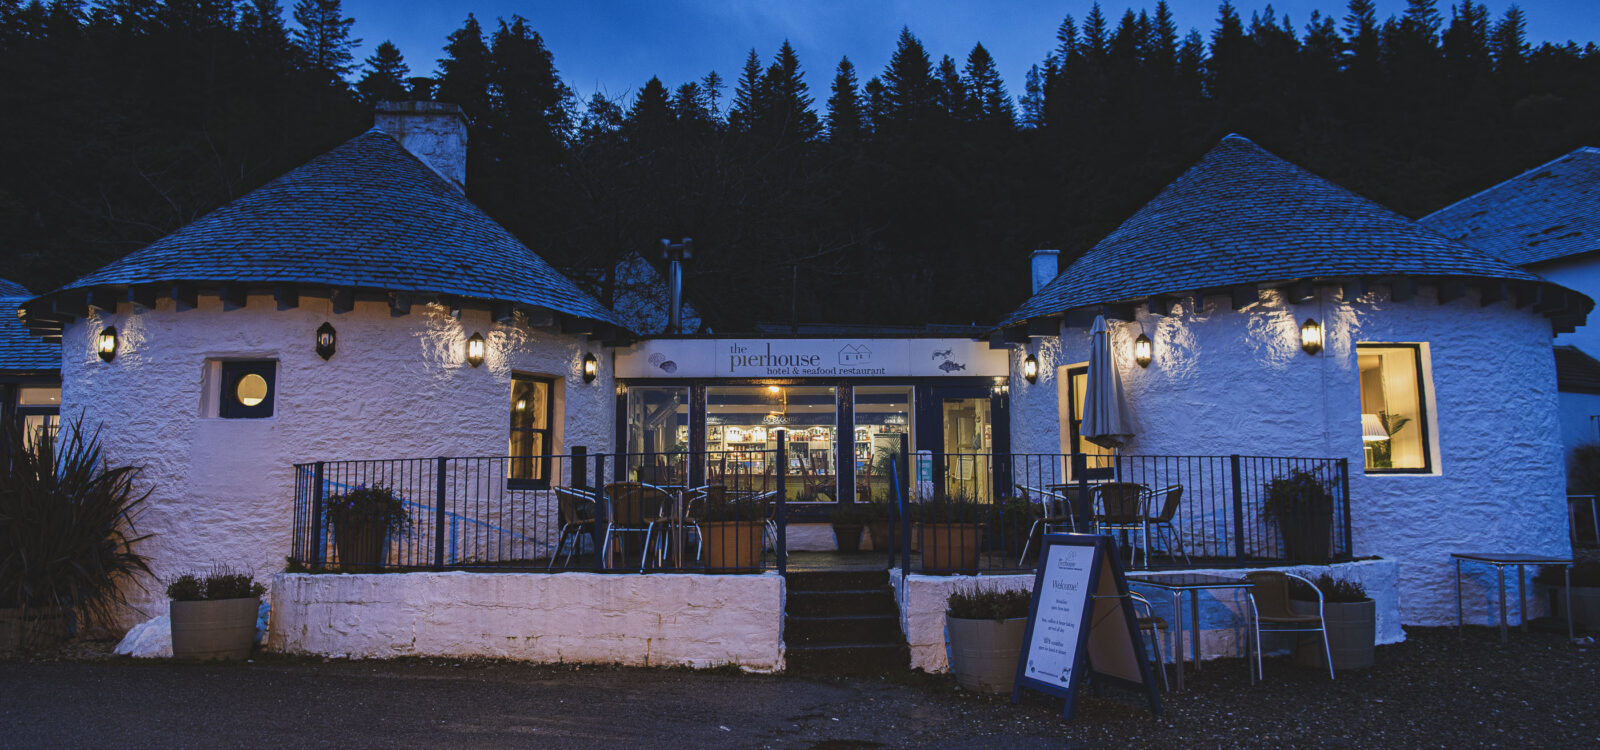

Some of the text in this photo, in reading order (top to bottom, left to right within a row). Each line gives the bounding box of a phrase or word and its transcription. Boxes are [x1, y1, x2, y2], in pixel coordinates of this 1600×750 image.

[730, 343, 747, 354] the
[729, 343, 820, 372] pierhouse
[766, 366, 885, 375] hotel & seafood restaurant
